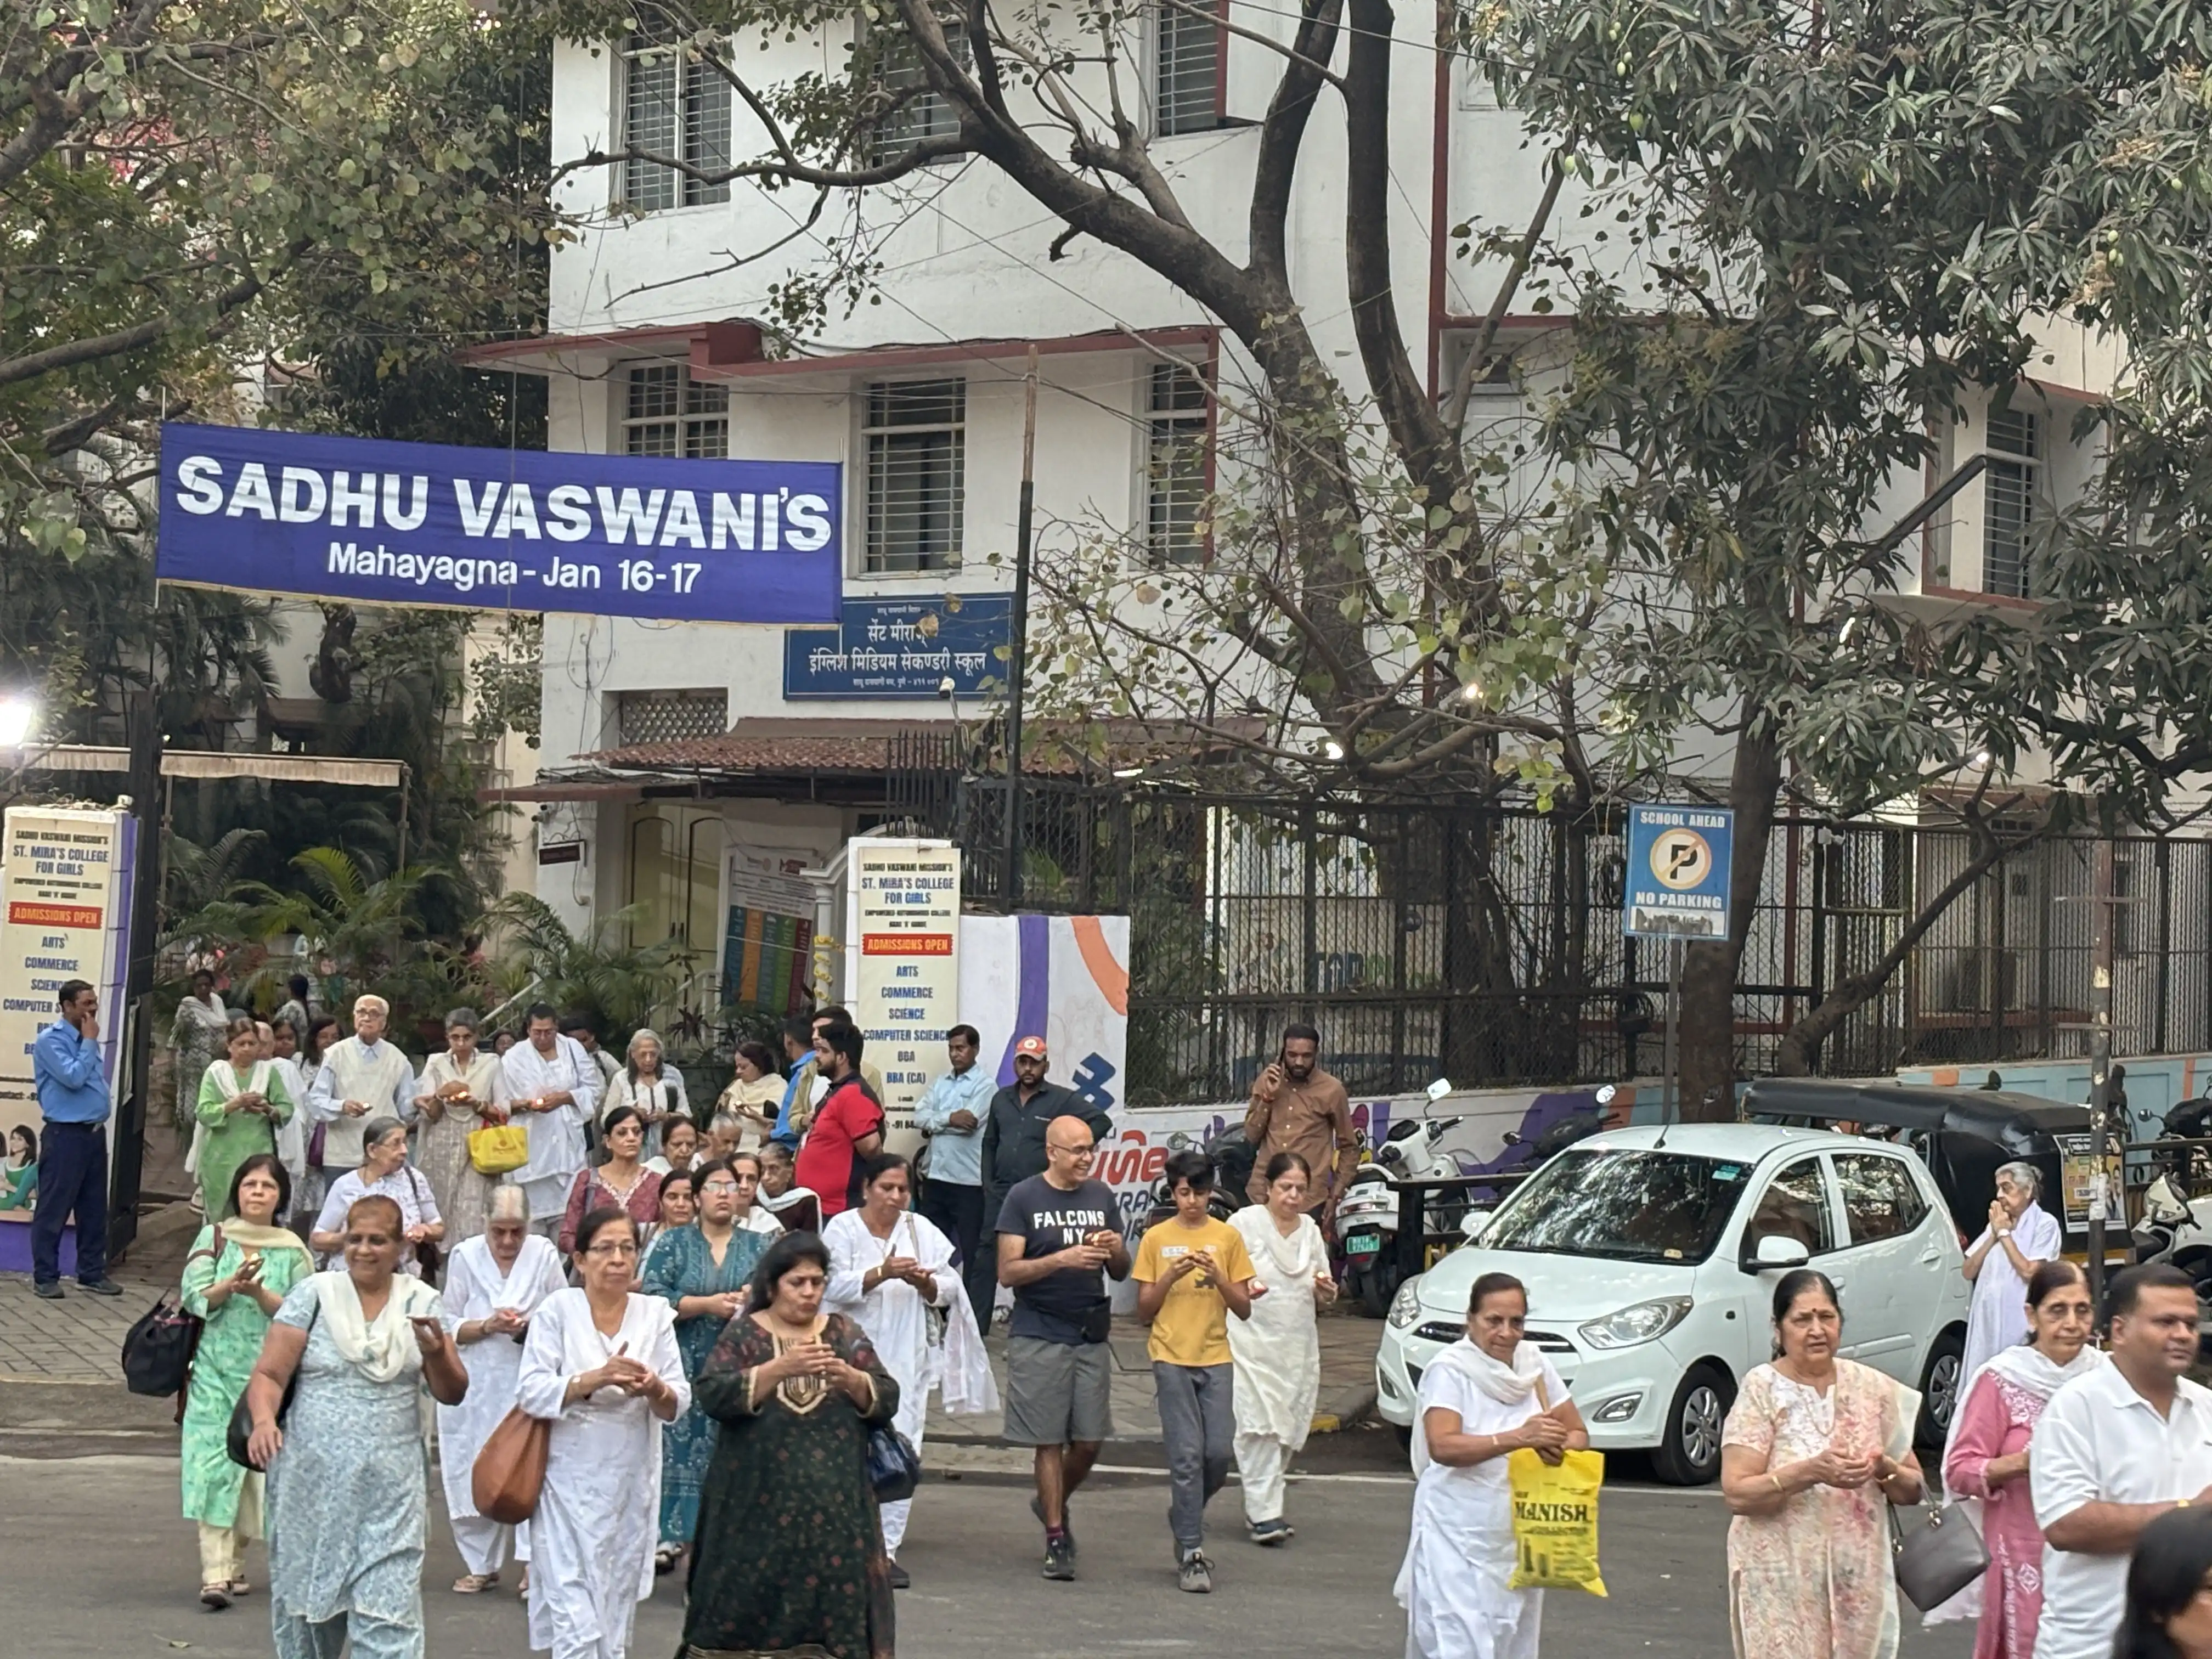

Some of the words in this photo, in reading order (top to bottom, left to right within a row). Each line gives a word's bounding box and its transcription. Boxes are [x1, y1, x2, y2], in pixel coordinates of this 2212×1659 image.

[176, 455, 428, 532] SADHU
[454, 478, 832, 552] VASWANI'S
[619, 559, 702, 593] 16-17
[851, 647, 898, 672] मिडियम
[953, 653, 986, 676] स्कूल
[1640, 811, 1684, 826] SCHOOL
[1689, 814, 1725, 828] AHEAD
[13, 845, 27, 857] ST.
[31, 846, 65, 860] MIRA'S
[68, 848, 109, 862] COLLEGE
[36, 861, 54, 874] FOR
[57, 862, 84, 876] GIRLS
[862, 878, 876, 889] ST.
[915, 878, 954, 890] COLLEGE
[885, 893, 902, 904] FOR
[905, 893, 932, 904] GIRLS
[1635, 891, 1655, 905] NO
[1659, 893, 1723, 909] PARKING
[14, 907, 72, 922] ADMISSIONS
[74, 911, 97, 924] OPEN
[41, 936, 65, 949] ARTS
[868, 939, 923, 950] ADMISSIONS
[924, 939, 948, 950] OPEN
[25, 957, 79, 971] COMMERCE
[896, 966, 918, 978] ARTS
[882, 987, 933, 998] COMMERCE
[3, 998, 53, 1012] COMPUTER
[889, 1008, 925, 1020] SCIENCE
[864, 1030, 911, 1041] COMPUTER
[887, 1072, 904, 1084] BBA
[907, 1072, 926, 1085] (CA)
[1033, 1210, 1105, 1229] FALCONS
[1515, 1502, 1588, 1522] MANISH
